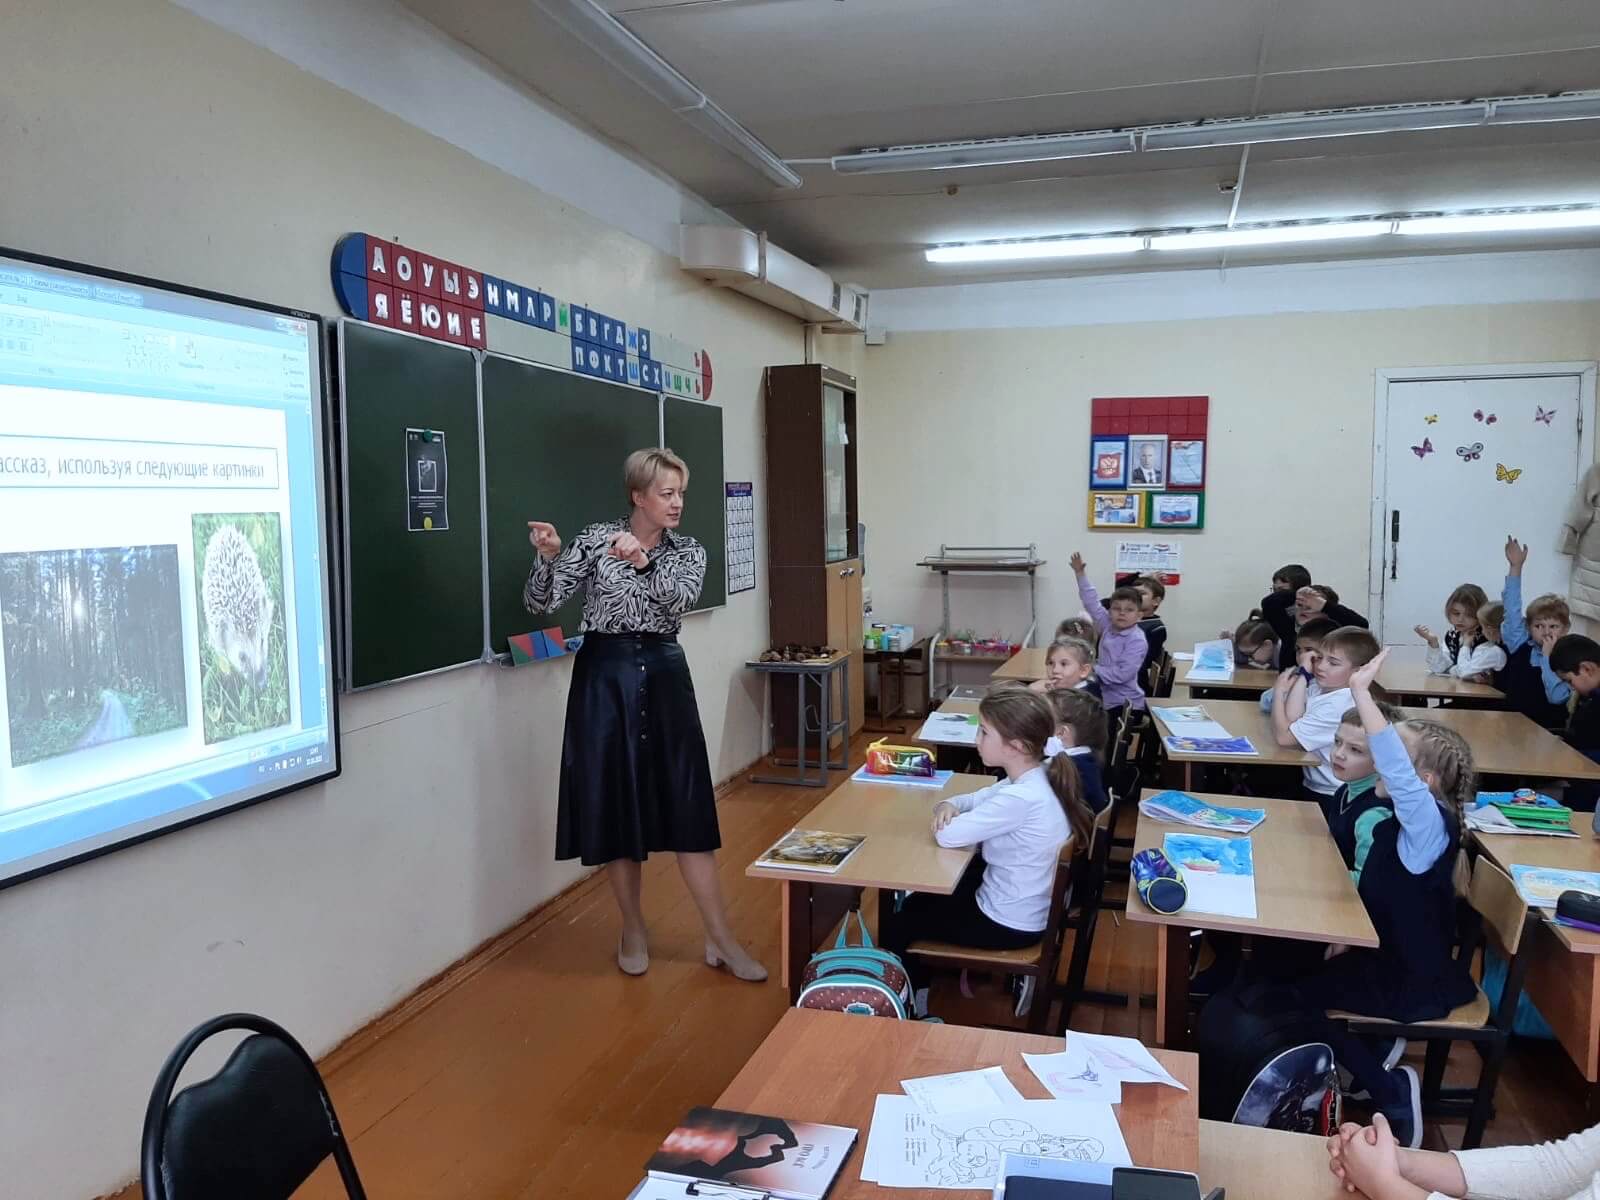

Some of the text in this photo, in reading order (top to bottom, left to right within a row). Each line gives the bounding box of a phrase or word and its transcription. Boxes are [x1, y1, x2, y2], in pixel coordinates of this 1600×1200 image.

[372, 246, 386, 273] А
[397, 256, 412, 281] О
[423, 262, 433, 287] У
[443, 269, 460, 294] Ы
[468, 276, 479, 299] Э
[488, 283, 498, 306] Н
[506, 290, 519, 312] М
[527, 296, 535, 318] Л
[543, 302, 551, 322] Р
[575, 313, 583, 332] Б
[590, 318, 597, 337] В
[604, 323, 610, 340] Г
[616, 326, 624, 345] Д
[628, 331, 638, 349] Ж
[642, 334, 647, 352] З
[375, 293, 388, 319] Я
[401, 293, 412, 324] Ё
[421, 303, 440, 329] Ю
[447, 312, 460, 336] И
[471, 317, 480, 339] Е
[575, 346, 584, 365] П
[589, 351, 599, 369] Ф
[604, 355, 612, 373] К
[618, 359, 625, 376] Т
[629, 362, 639, 379] Ш
[643, 365, 649, 381] С
[654, 368, 660, 384] Х
[673, 375, 682, 392] Щ
[685, 377, 691, 393] Ч
[58, 456, 131, 480] используя
[136, 460, 208, 480] следующие
[213, 462, 264, 480] картинки
